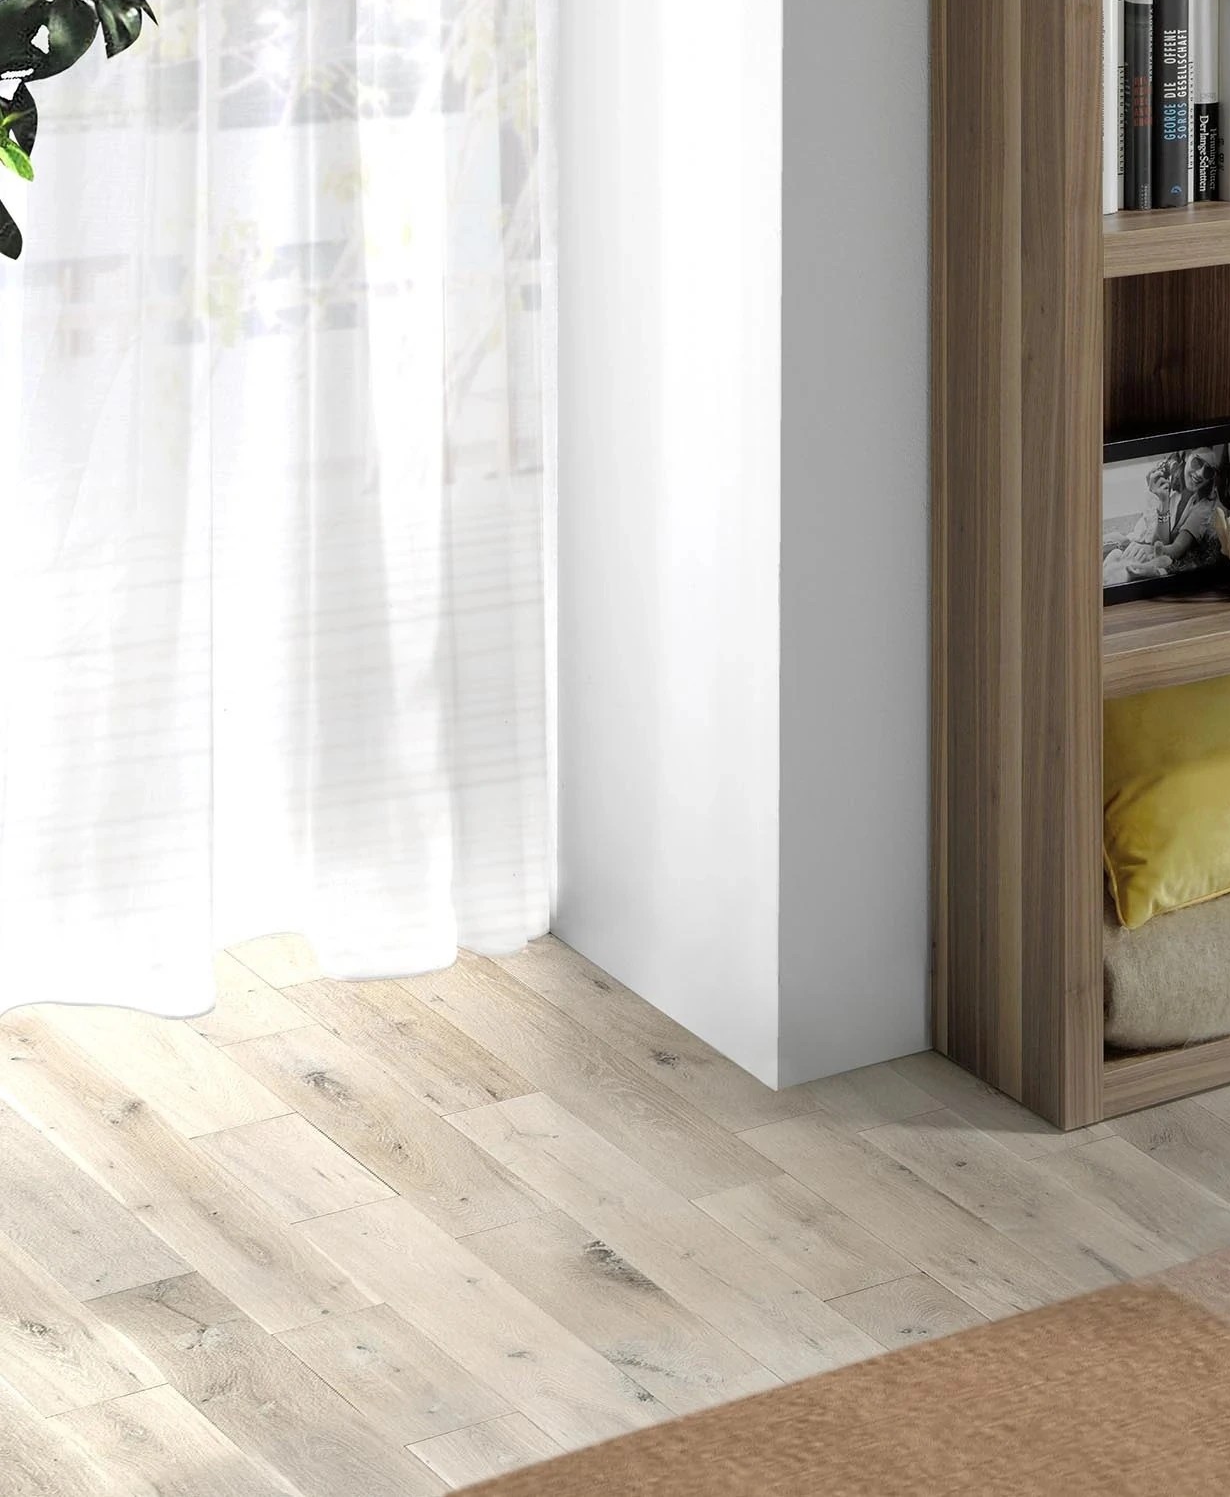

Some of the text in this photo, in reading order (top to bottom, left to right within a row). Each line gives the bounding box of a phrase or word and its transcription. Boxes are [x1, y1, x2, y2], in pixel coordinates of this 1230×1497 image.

[1164, 29, 1176, 99] DIE OFFENE
[1177, 29, 1188, 98] GESELLSCHAFT
[1164, 102, 1176, 140] GEORGE
[1177, 102, 1187, 139] SOROS
[1197, 115, 1210, 192] Der lange Schatten
[1208, 128, 1217, 190] Henning Ritter
